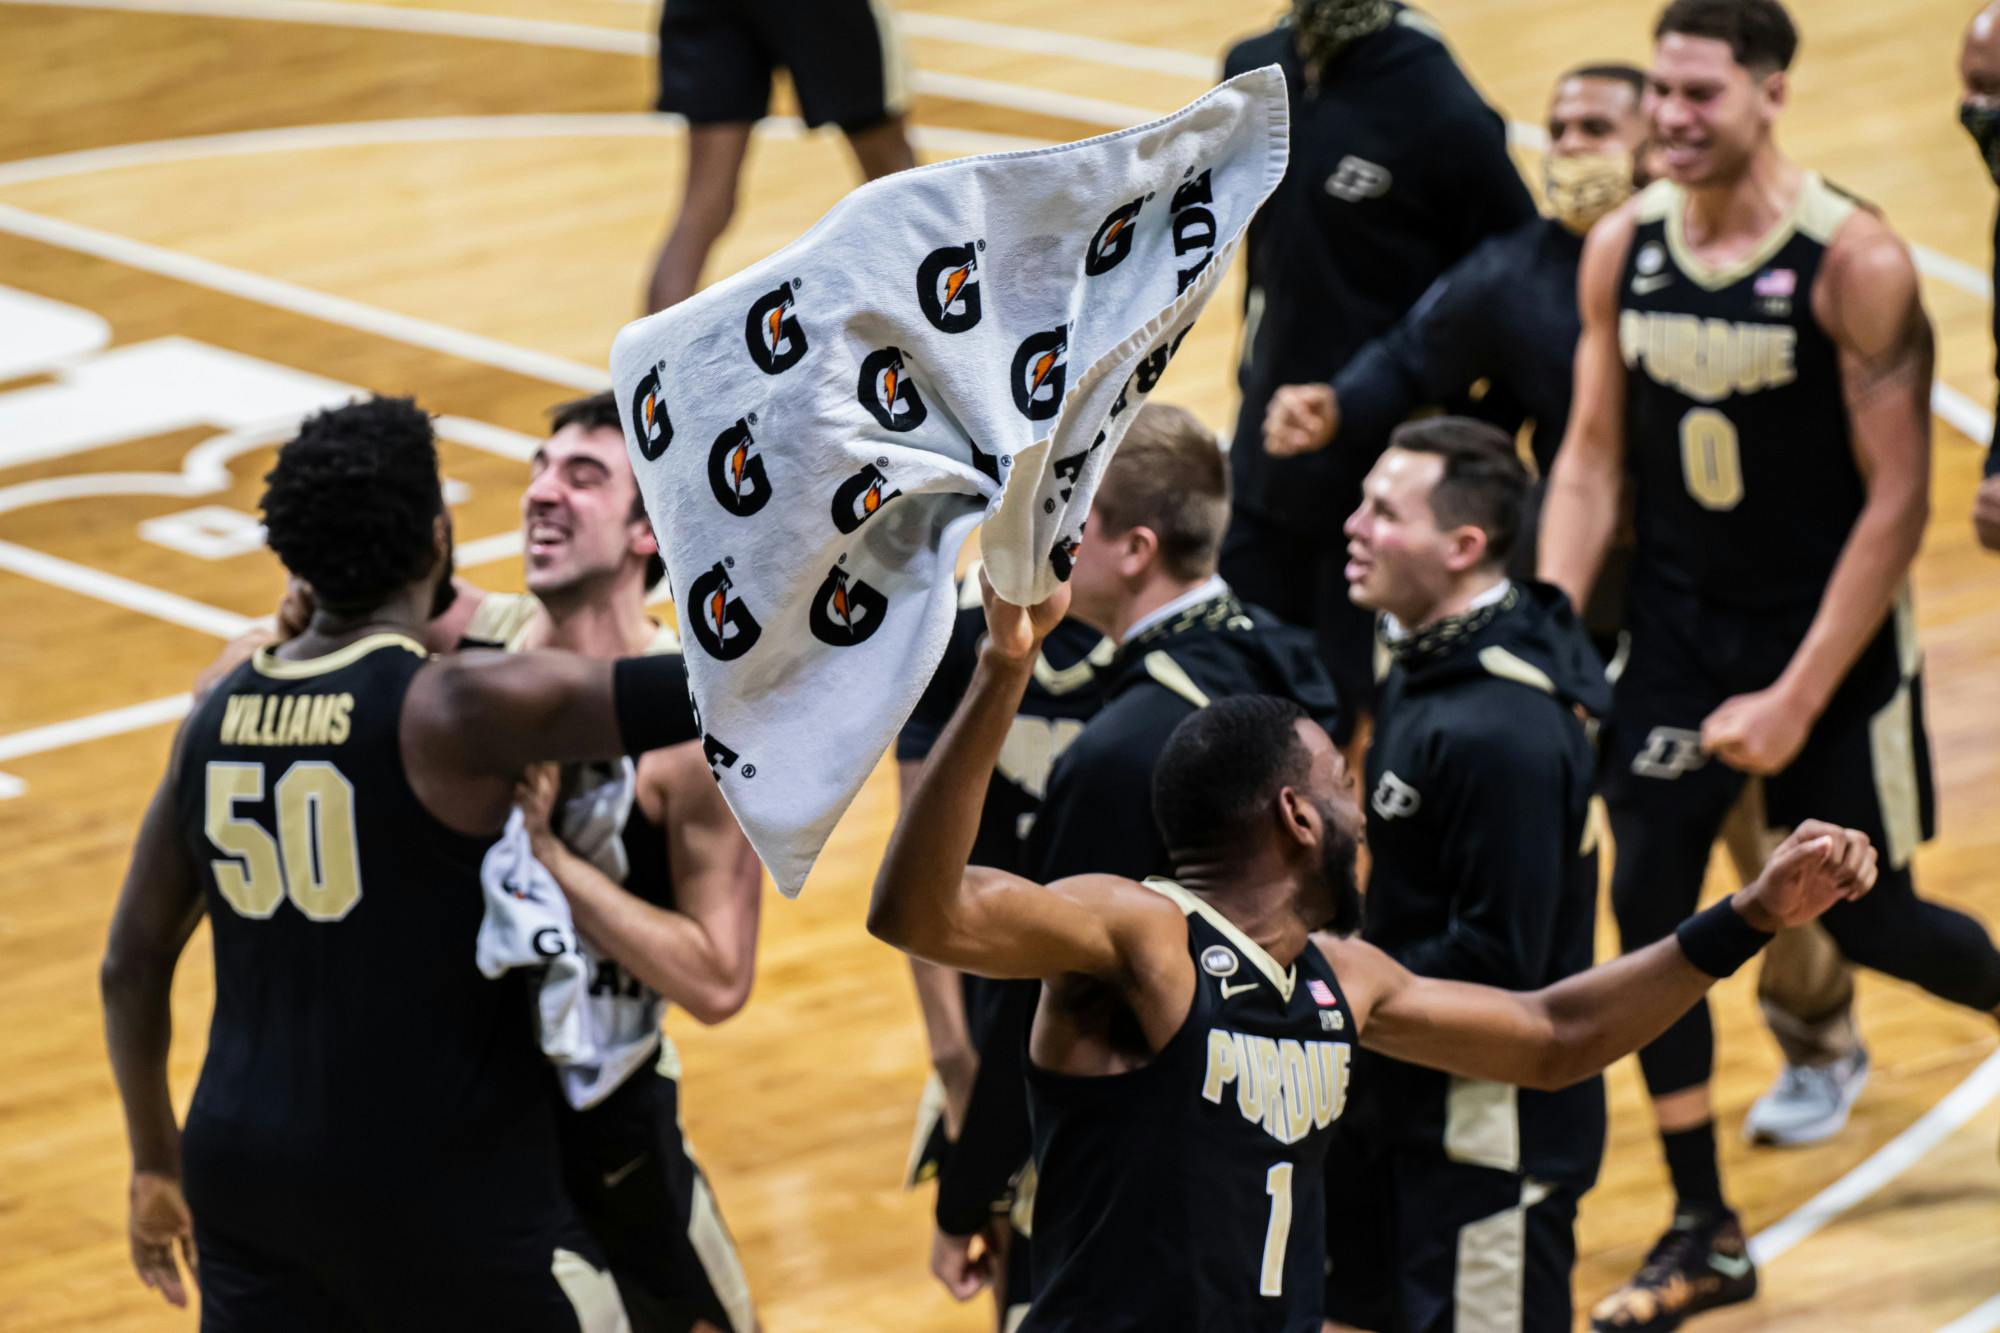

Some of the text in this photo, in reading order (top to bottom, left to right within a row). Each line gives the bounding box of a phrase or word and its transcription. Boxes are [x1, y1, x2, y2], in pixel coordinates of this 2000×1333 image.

[1619, 309, 1797, 402] PURDUE
[1679, 407, 1744, 511] 0
[219, 691, 355, 748] WILLIAMS
[204, 760, 364, 923] 50
[1202, 1028, 1352, 1145] PURDUE
[1259, 1160, 1294, 1297] 1
